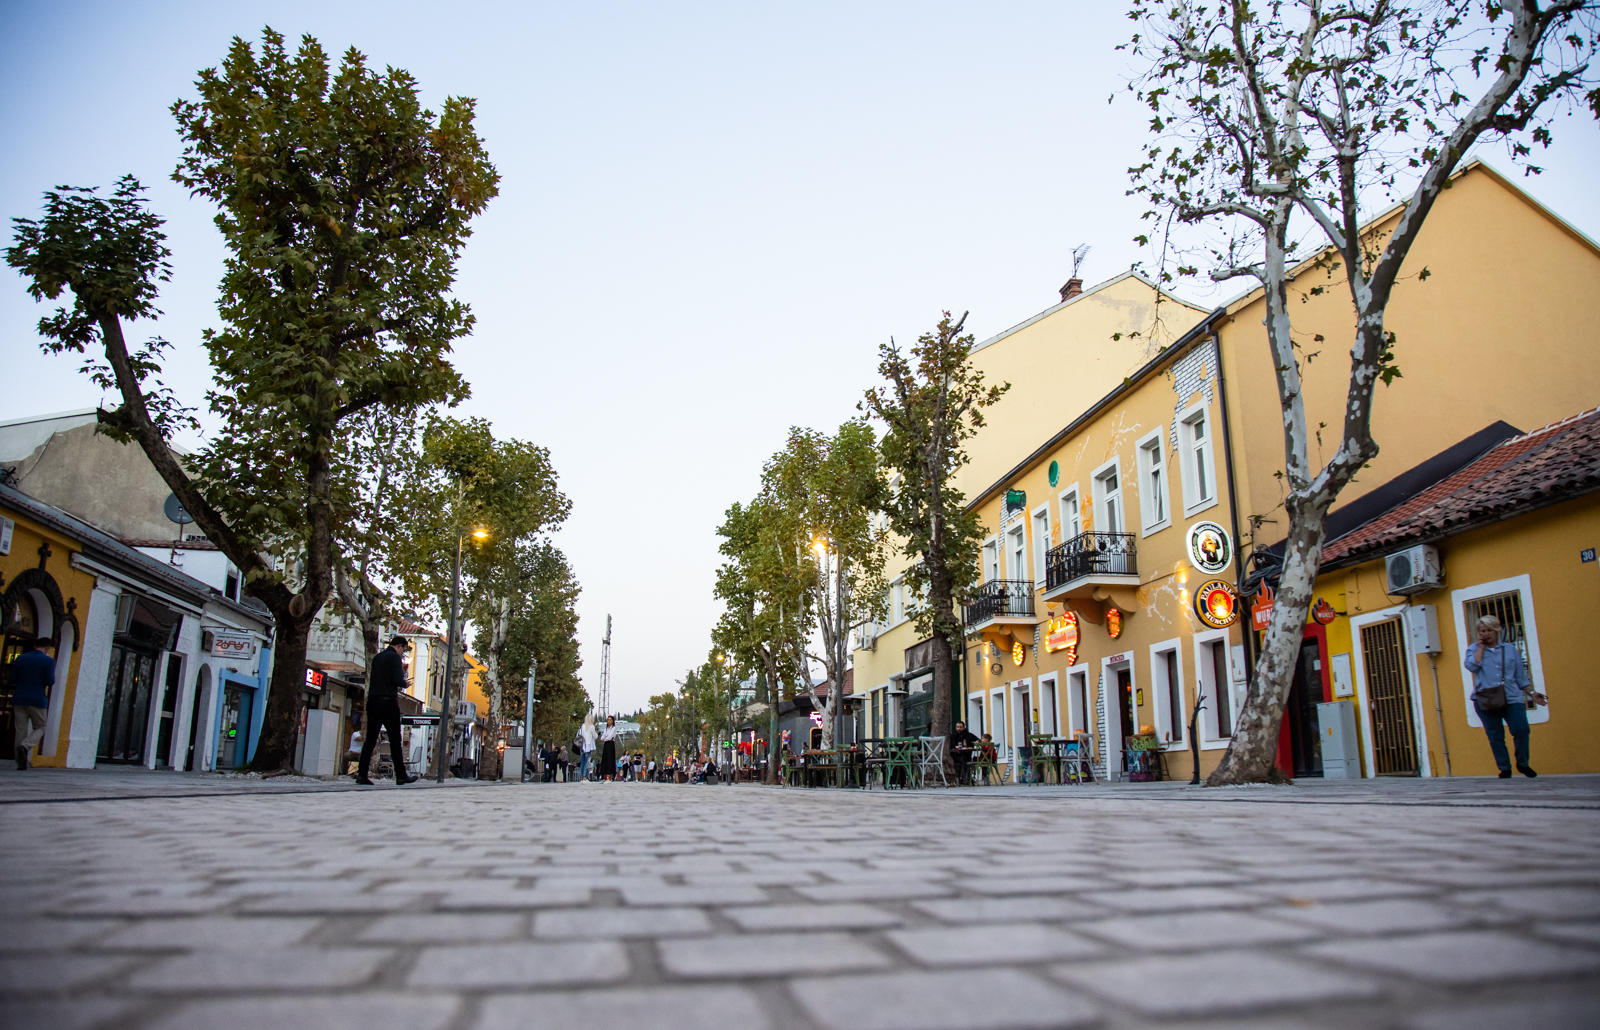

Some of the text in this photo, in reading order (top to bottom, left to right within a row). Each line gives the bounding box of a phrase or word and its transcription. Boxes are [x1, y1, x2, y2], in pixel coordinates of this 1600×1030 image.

[1582, 549, 1594, 561] 30
[1200, 582, 1237, 600] PAULANER
[1317, 611, 1334, 619] WURST
